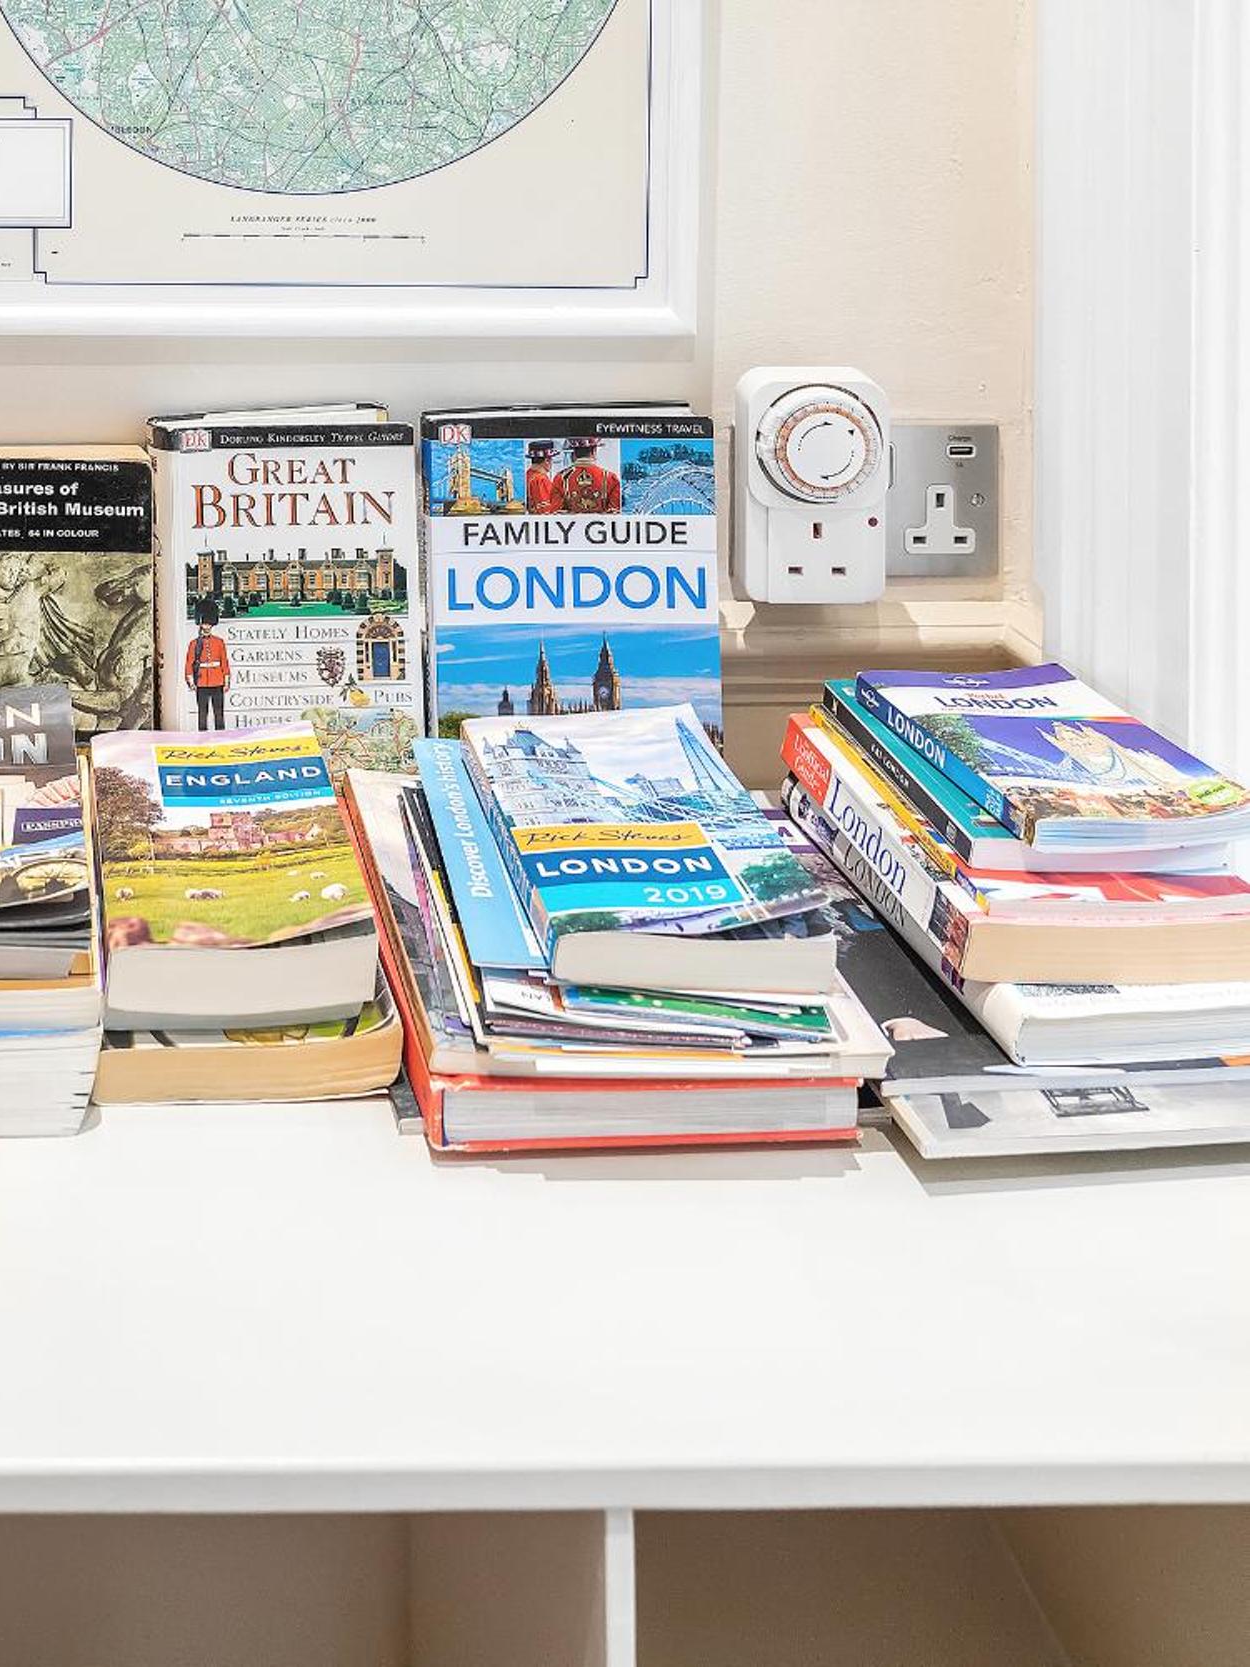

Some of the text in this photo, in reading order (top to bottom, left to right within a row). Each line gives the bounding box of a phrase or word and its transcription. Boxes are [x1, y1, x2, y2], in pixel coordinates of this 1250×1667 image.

[441, 426, 469, 442] DK
[596, 423, 705, 434] EYEWITNESS TRAVEL
[185, 432, 207, 448] DK
[2, 463, 15, 471] BY
[18, 463, 35, 471] SIR
[37, 463, 72, 472] FRANK
[74, 463, 120, 473] FRANCIS
[227, 453, 356, 486] GREAT
[59, 482, 80, 496] of
[65, 502, 145, 517] Museum
[191, 484, 397, 530] BRITAIN
[28, 529, 41, 538] 64
[43, 529, 54, 538] IN
[56, 529, 100, 538] COLOUR
[462, 521, 688, 546] FAMILY GUIDE
[447, 565, 708, 611] LONDON
[227, 625, 350, 640] STATELY HOMES
[230, 648, 303, 663] GARDENS
[236, 670, 309, 684] MUSEUMS
[229, 693, 335, 708] COUNTRYSIDE
[374, 690, 413, 704] PUBS
[933, 696, 1060, 710] LONDON
[887, 706, 946, 770] LONDON
[165, 766, 323, 787] ENGLAND
[442, 783, 476, 838] London's
[521, 829, 692, 847] Rick Steves
[828, 776, 907, 897] London
[461, 839, 494, 898] Discover
[536, 856, 713, 878] LONDON
[643, 884, 728, 903] 2019
[843, 842, 907, 928] LONDON
